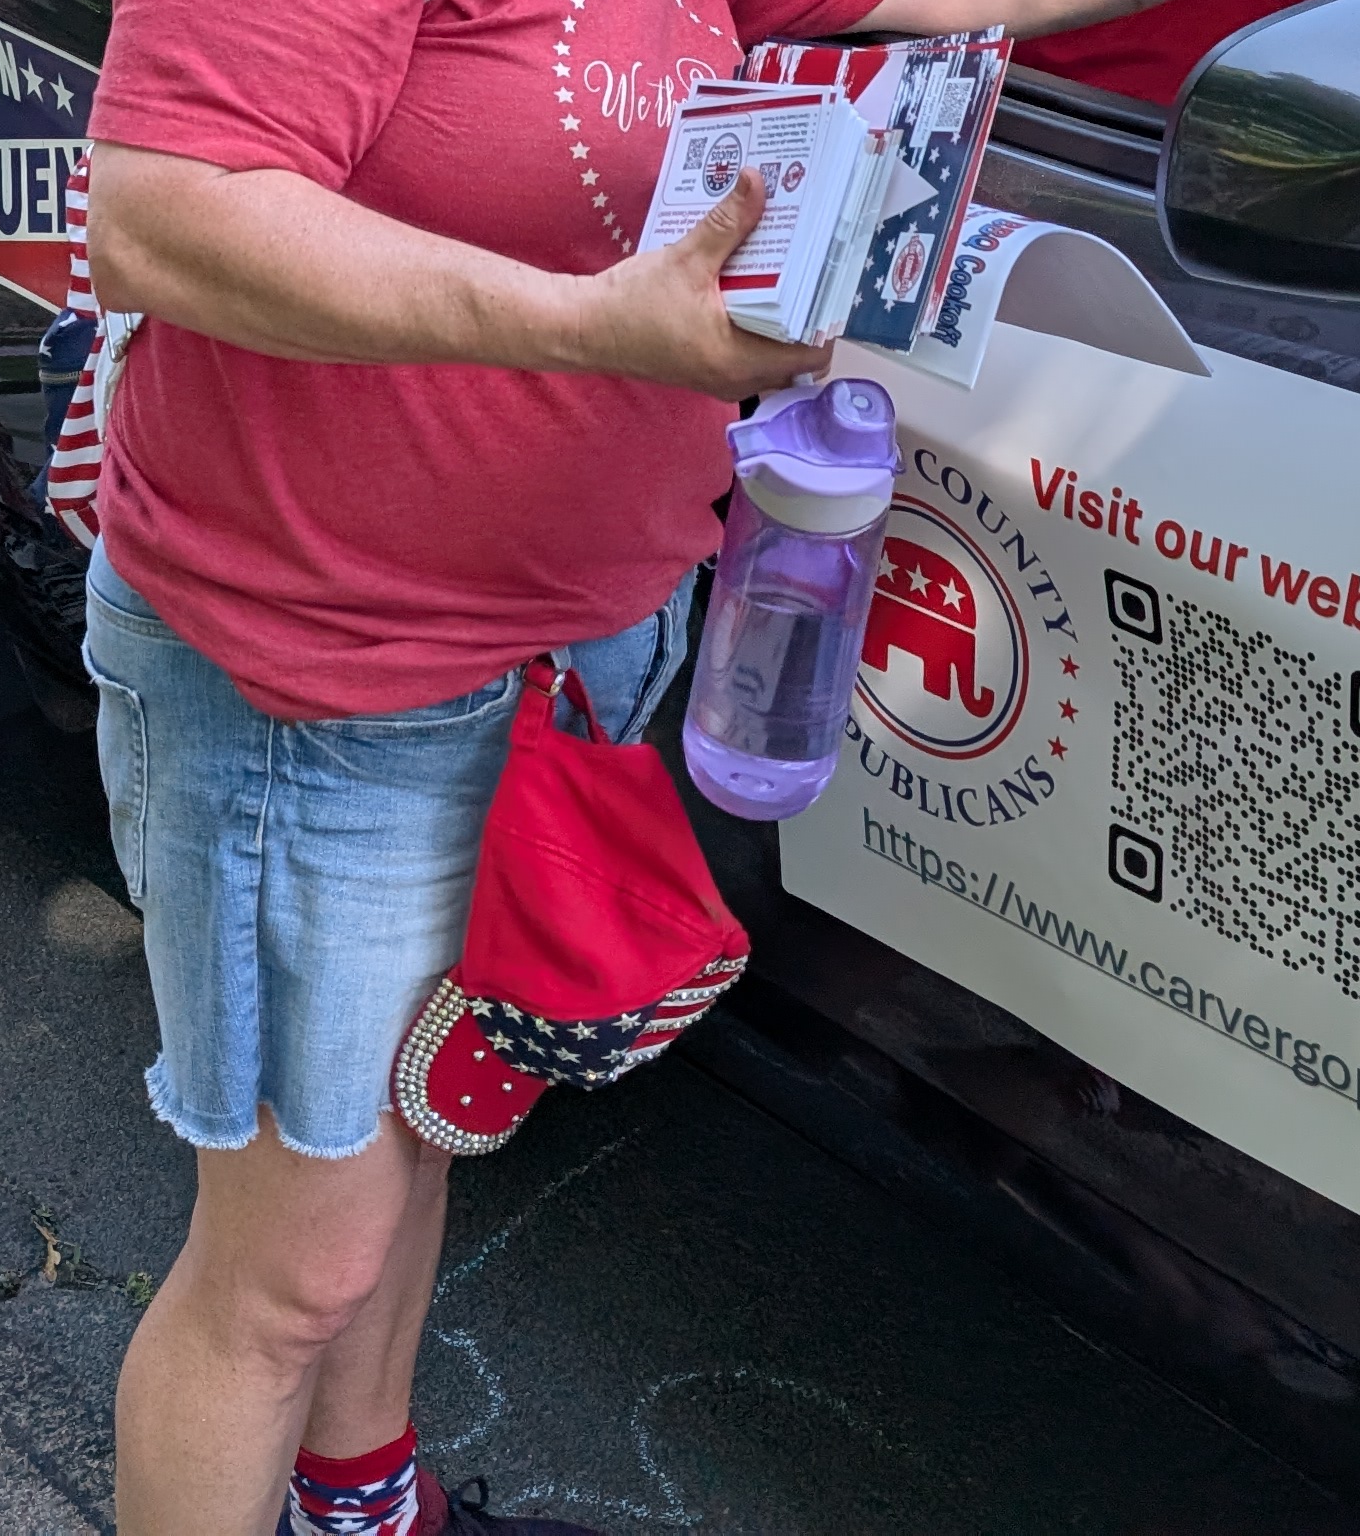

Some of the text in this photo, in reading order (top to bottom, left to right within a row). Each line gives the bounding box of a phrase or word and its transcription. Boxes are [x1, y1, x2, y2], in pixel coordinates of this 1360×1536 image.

[584, 60, 651, 133] We
[647, 74, 688, 128] th
[935, 254, 986, 349] Cookoff
[914, 448, 1079, 644] COUNTY
[1030, 457, 1143, 546] Visit
[1154, 519, 1249, 583] our
